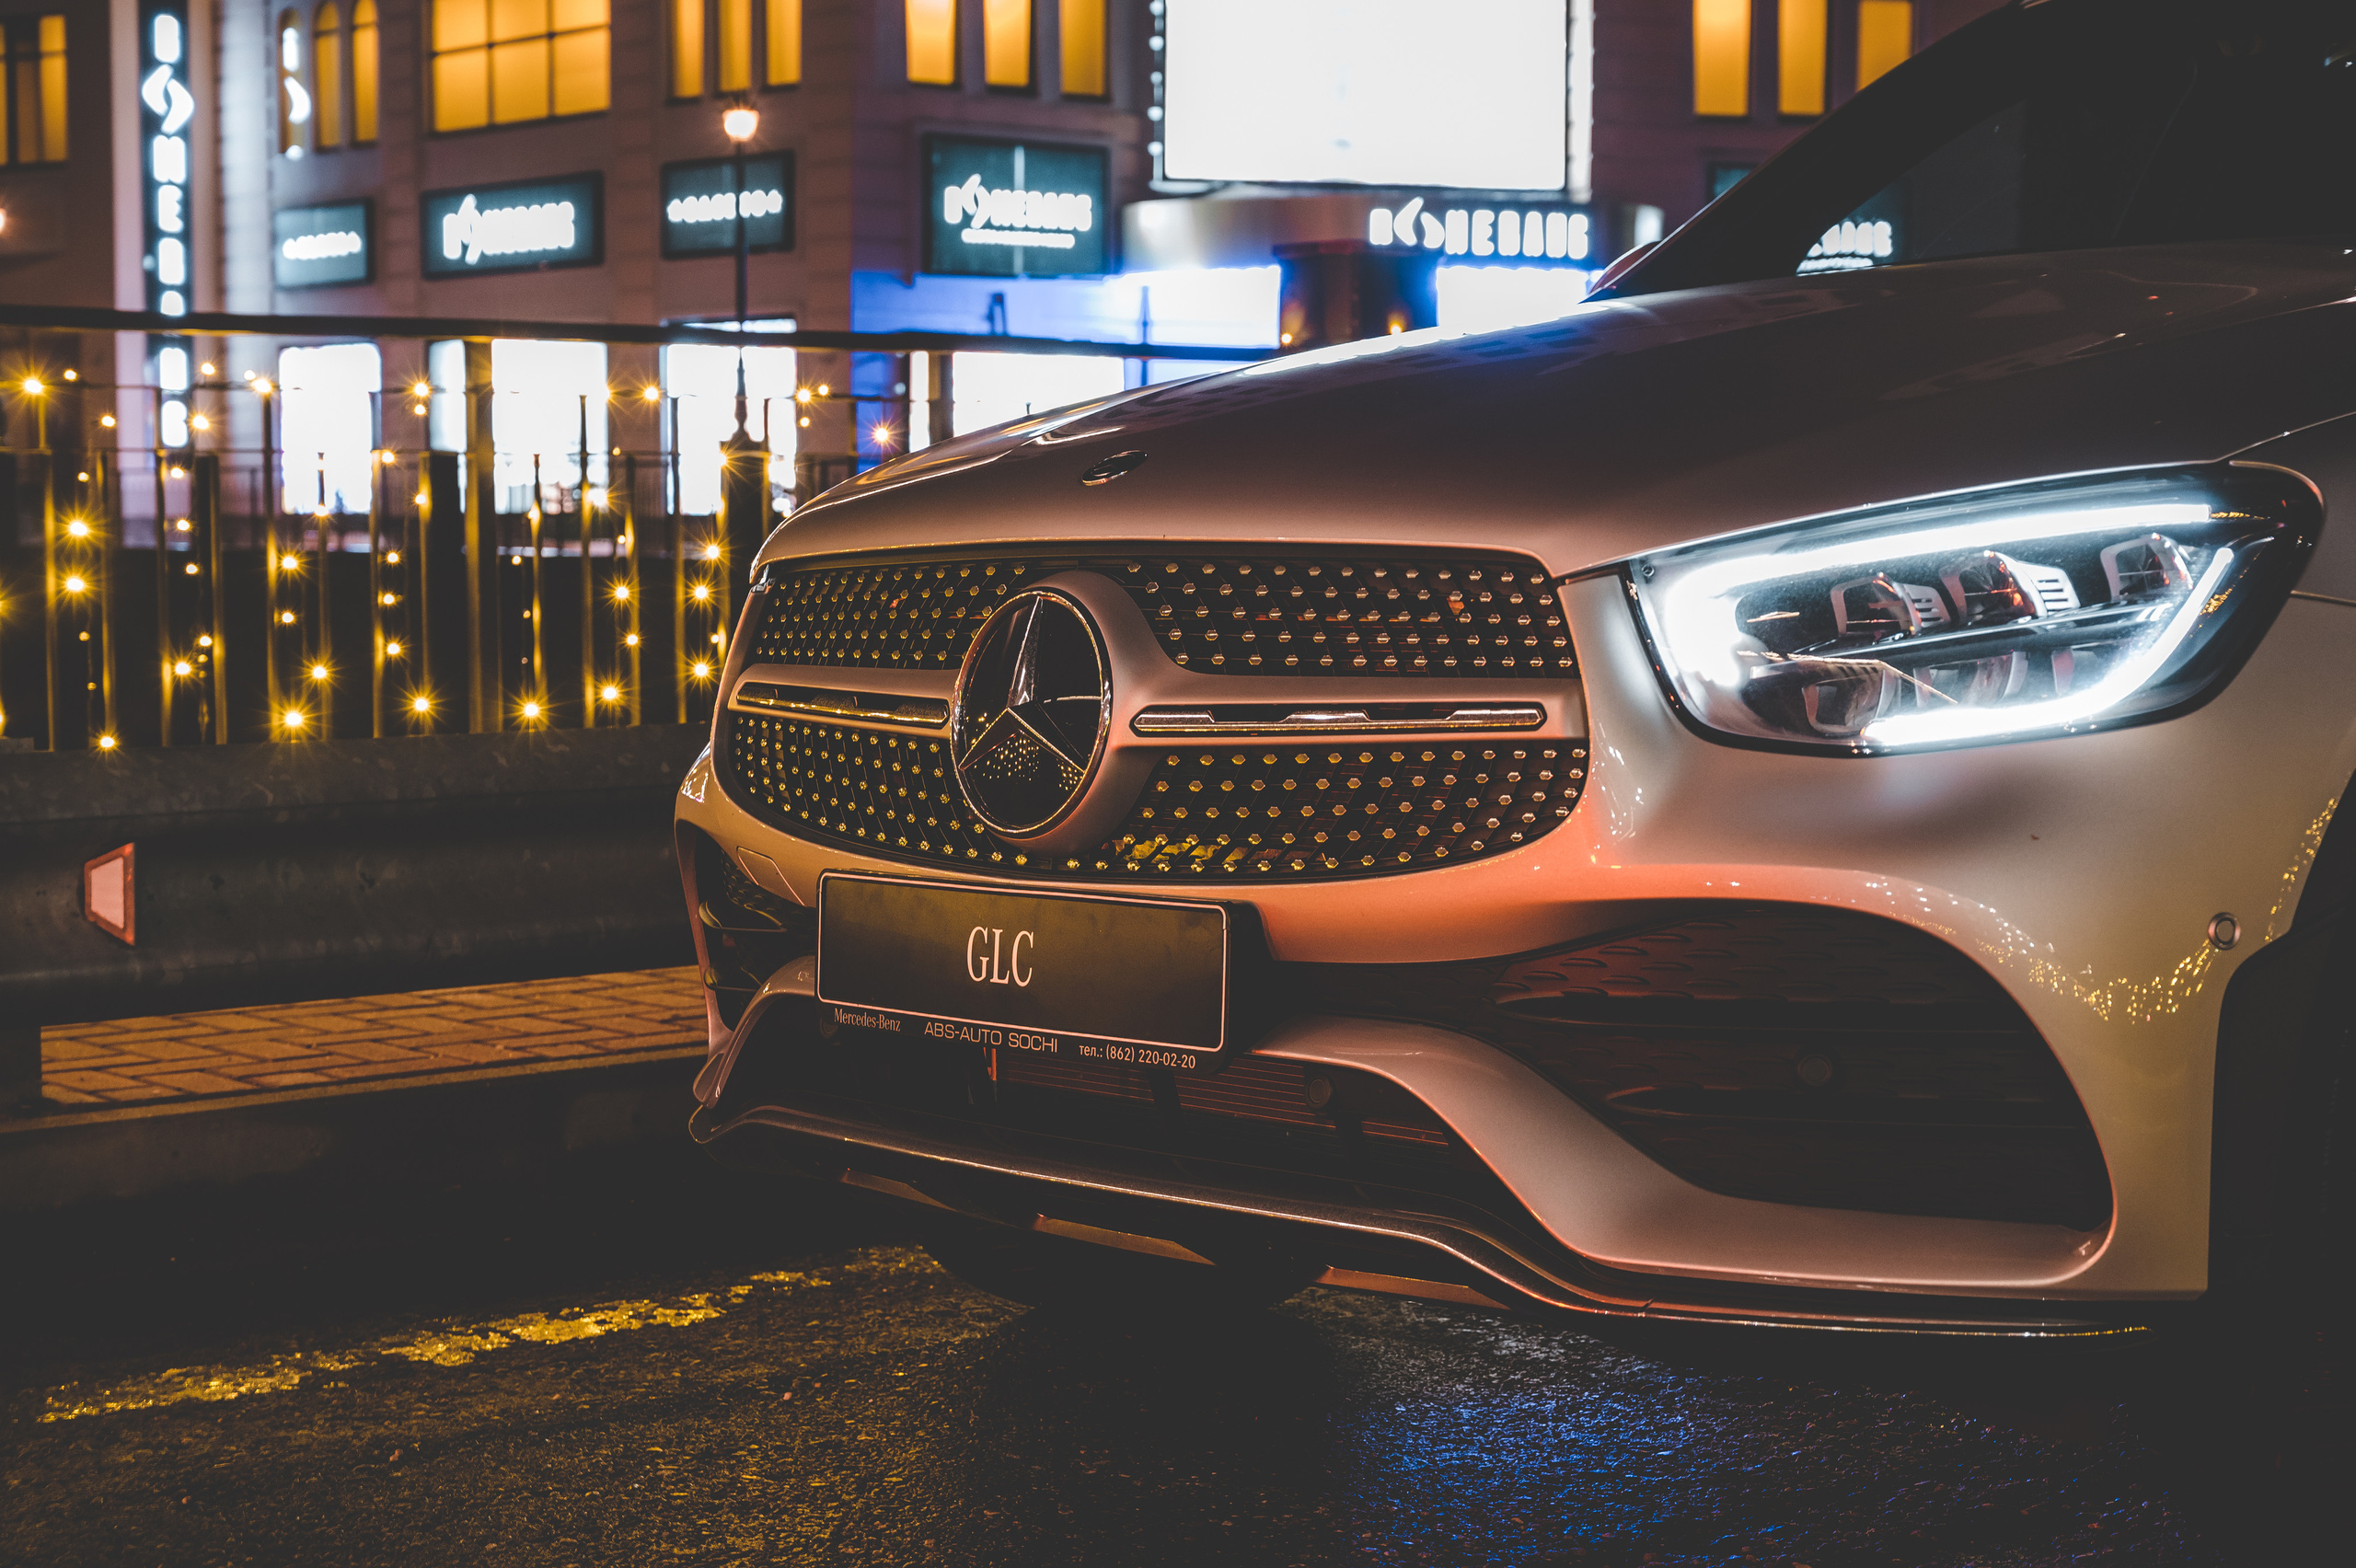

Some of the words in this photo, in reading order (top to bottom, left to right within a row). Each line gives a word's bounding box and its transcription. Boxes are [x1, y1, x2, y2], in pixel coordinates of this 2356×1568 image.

[966, 926, 1034, 987] GLC
[834, 1008, 901, 1032] Mercedes-Benz
[924, 1021, 1002, 1045] ABS-AUTO
[1008, 1032, 1057, 1054] SOCHI
[1079, 1044, 1103, 1058] тел.:
[1106, 1043, 1135, 1063] (862)
[1138, 1049, 1196, 1069] 220-02-20
